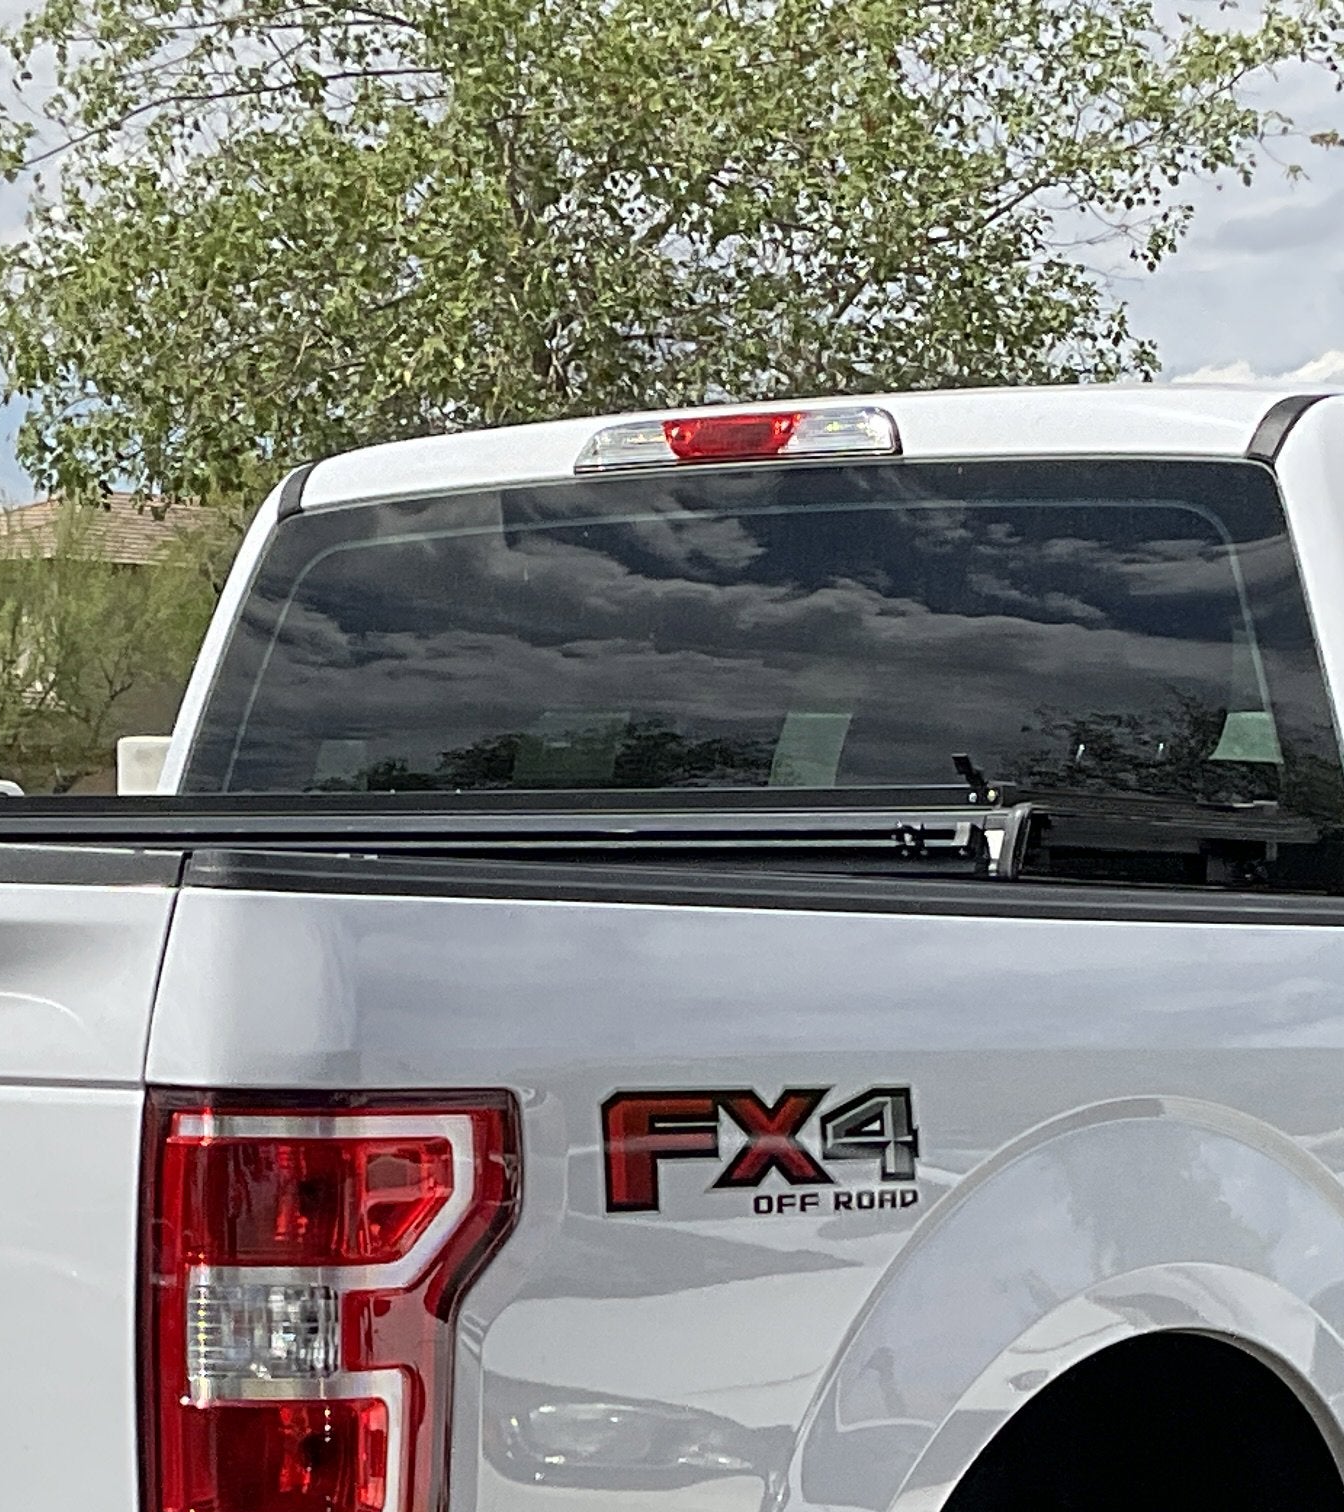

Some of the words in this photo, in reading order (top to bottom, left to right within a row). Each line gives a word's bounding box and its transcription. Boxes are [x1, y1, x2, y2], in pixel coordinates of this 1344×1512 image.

[601, 1087, 919, 1213] FX4
[753, 1193, 820, 1215] OFF
[833, 1189, 919, 1212] ROAD
